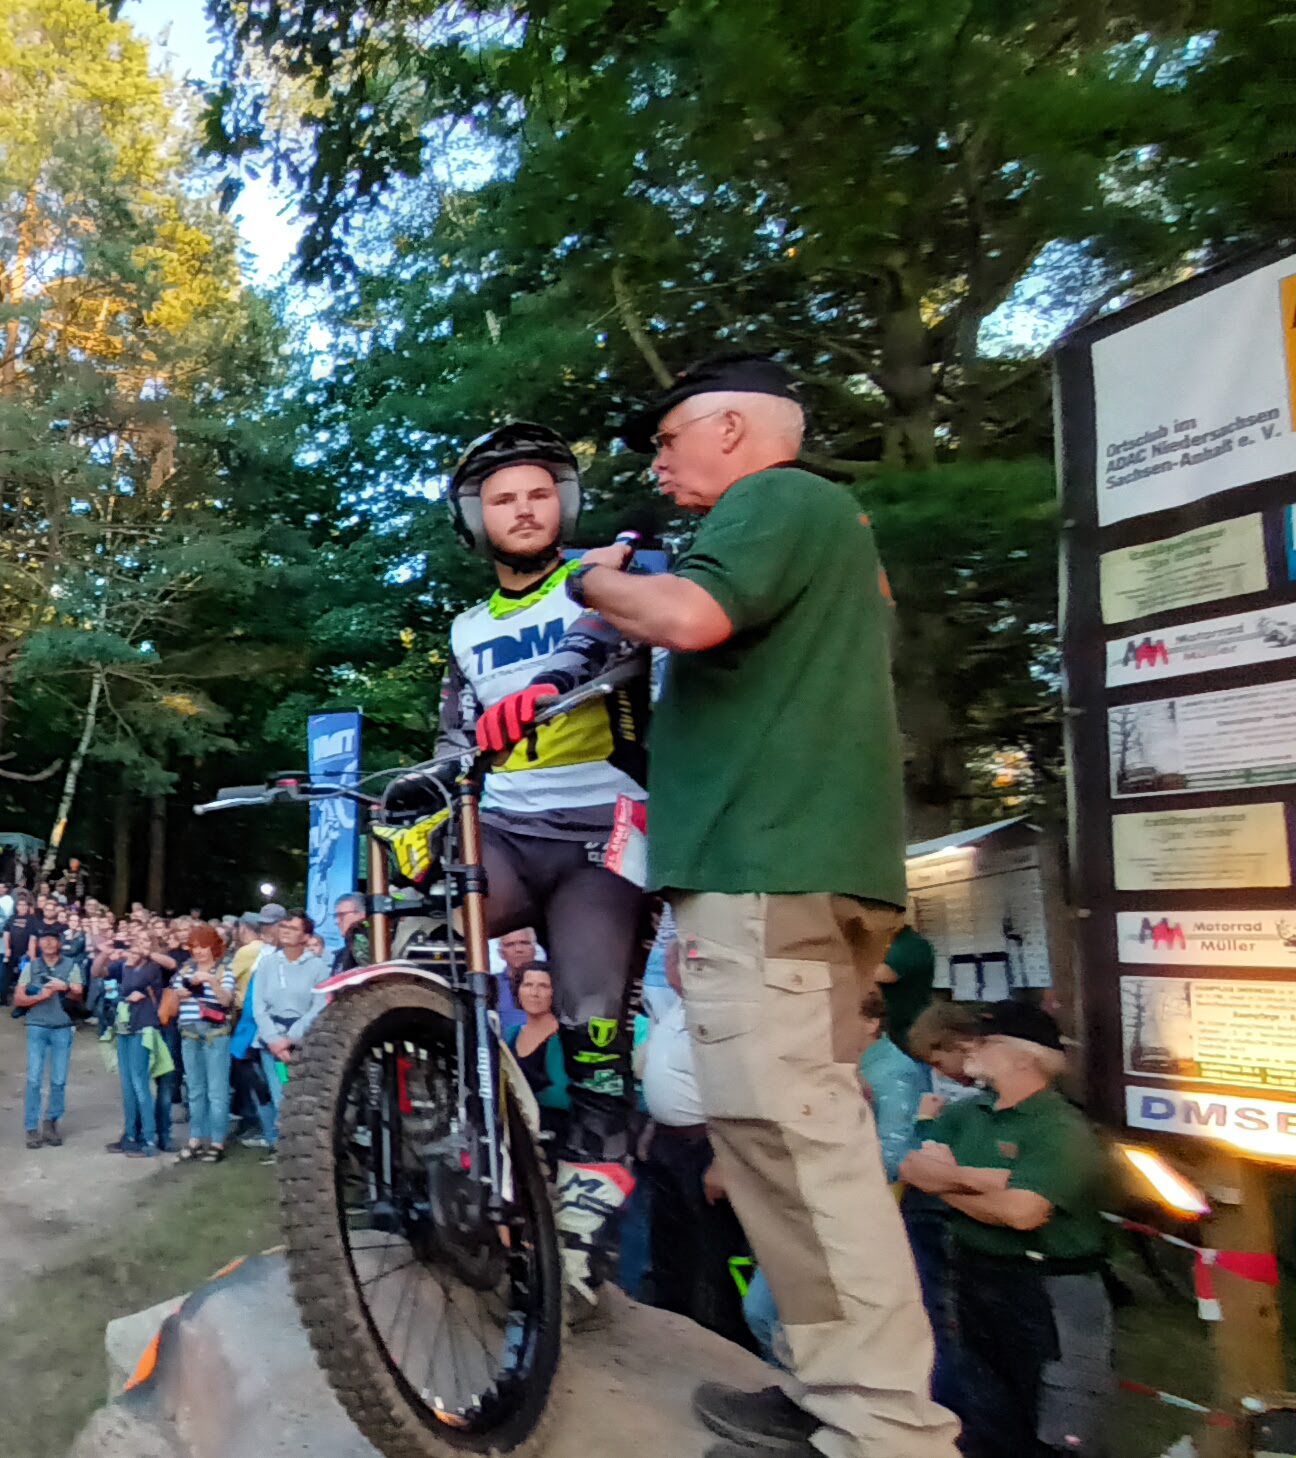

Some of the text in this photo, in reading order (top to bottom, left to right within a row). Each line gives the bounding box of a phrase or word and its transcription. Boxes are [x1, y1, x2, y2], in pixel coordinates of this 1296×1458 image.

[1173, 418, 1198, 434] im
[1106, 407, 1281, 475] ADAC Niedersachsen
[1105, 438, 1234, 490] Sachsen-Anhalt
[1261, 422, 1283, 441] V.
[1192, 921, 1263, 933] Motorrad
[1200, 938, 1257, 951] Müller
